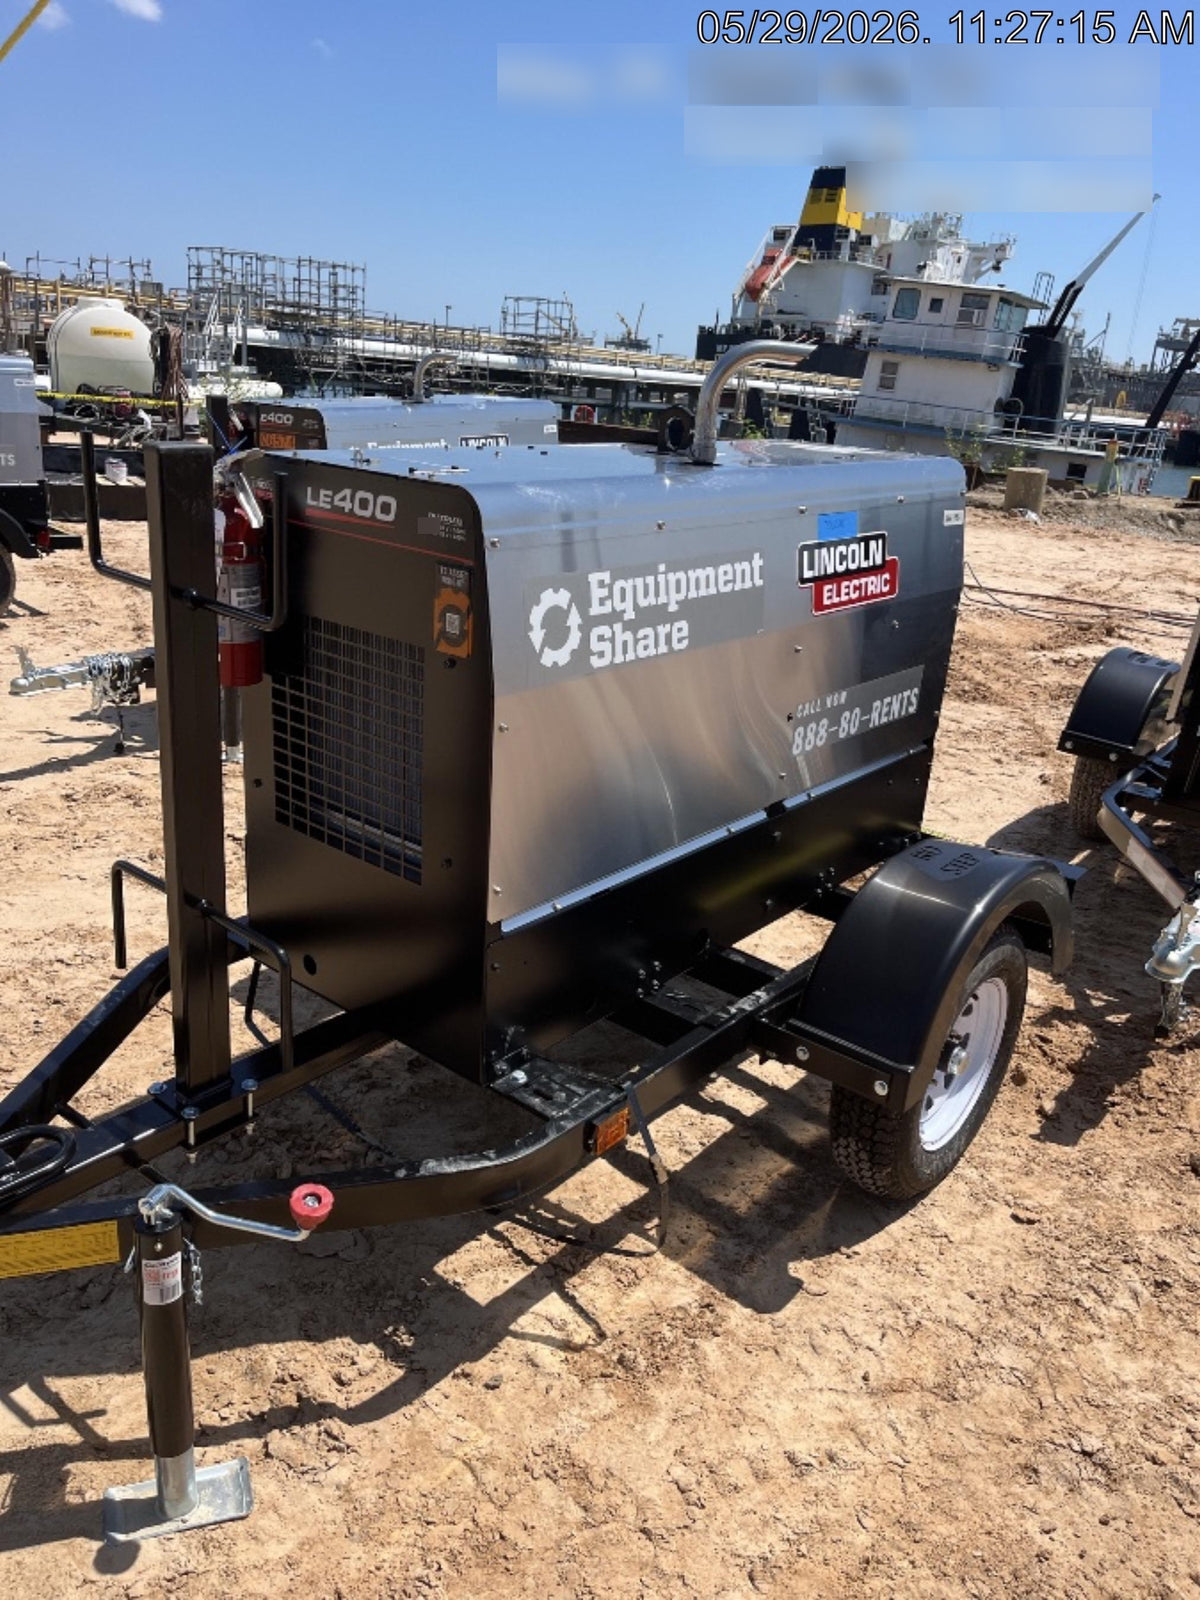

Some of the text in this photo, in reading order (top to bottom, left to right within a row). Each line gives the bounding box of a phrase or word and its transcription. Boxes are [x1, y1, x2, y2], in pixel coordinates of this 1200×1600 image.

[260, 411, 294, 424] E400
[0, 453, 15, 467] TS
[306, 486, 398, 522] LE400
[803, 538, 883, 579] LINCOLN
[588, 552, 764, 621] Equipment
[822, 572, 891, 605] ELECTRIC
[589, 619, 690, 669] Share
[792, 687, 919, 756] 888-80-RENTS
[796, 690, 848, 718] CALL NOW
